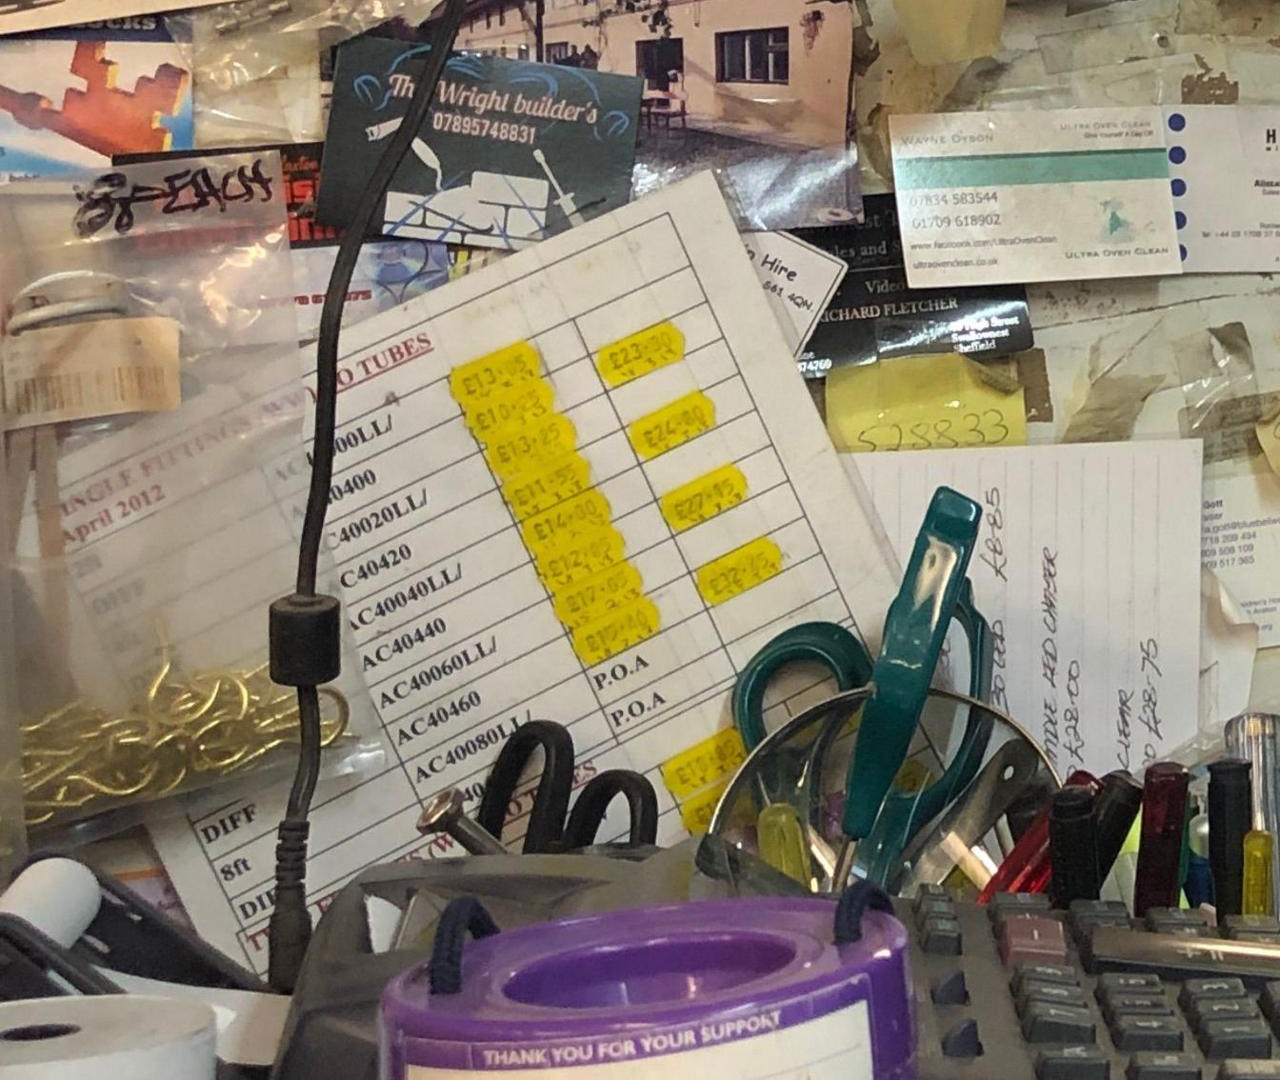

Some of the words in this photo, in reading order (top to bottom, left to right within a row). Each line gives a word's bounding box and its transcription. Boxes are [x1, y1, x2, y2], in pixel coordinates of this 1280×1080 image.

[389, 74, 416, 99] Th
[437, 79, 507, 115] Wright
[513, 94, 598, 124] builder's
[432, 112, 536, 145] 07895748831
[902, 134, 946, 146] WAYNE
[952, 133, 994, 144] DYSON
[952, 192, 998, 205] 583544
[955, 215, 1001, 227] 618902
[860, 243, 887, 257] and
[1065, 251, 1099, 260] ULTRA
[1102, 249, 1130, 257] OVEN
[1134, 247, 1169, 256] CLEAN
[761, 254, 797, 282] Hire
[883, 298, 958, 317] FLETCHER
[360, 331, 434, 378] TUBES
[119, 484, 166, 518] 2012
[360, 616, 447, 671] AC40440
[377, 635, 498, 710] AC40060LL/
[593, 654, 650, 692] P.O.A
[395, 689, 483, 746] AC40460
[610, 689, 667, 729] P.O.A
[200, 804, 258, 845] DIFF
[220, 857, 251, 882] 8ft
[482, 1048, 547, 1066] THANK
[550, 1046, 594, 1064] YOU
[598, 1041, 636, 1060] FOR
[639, 1030, 696, 1054] YOUR
[701, 1011, 782, 1042] SUPPORT
